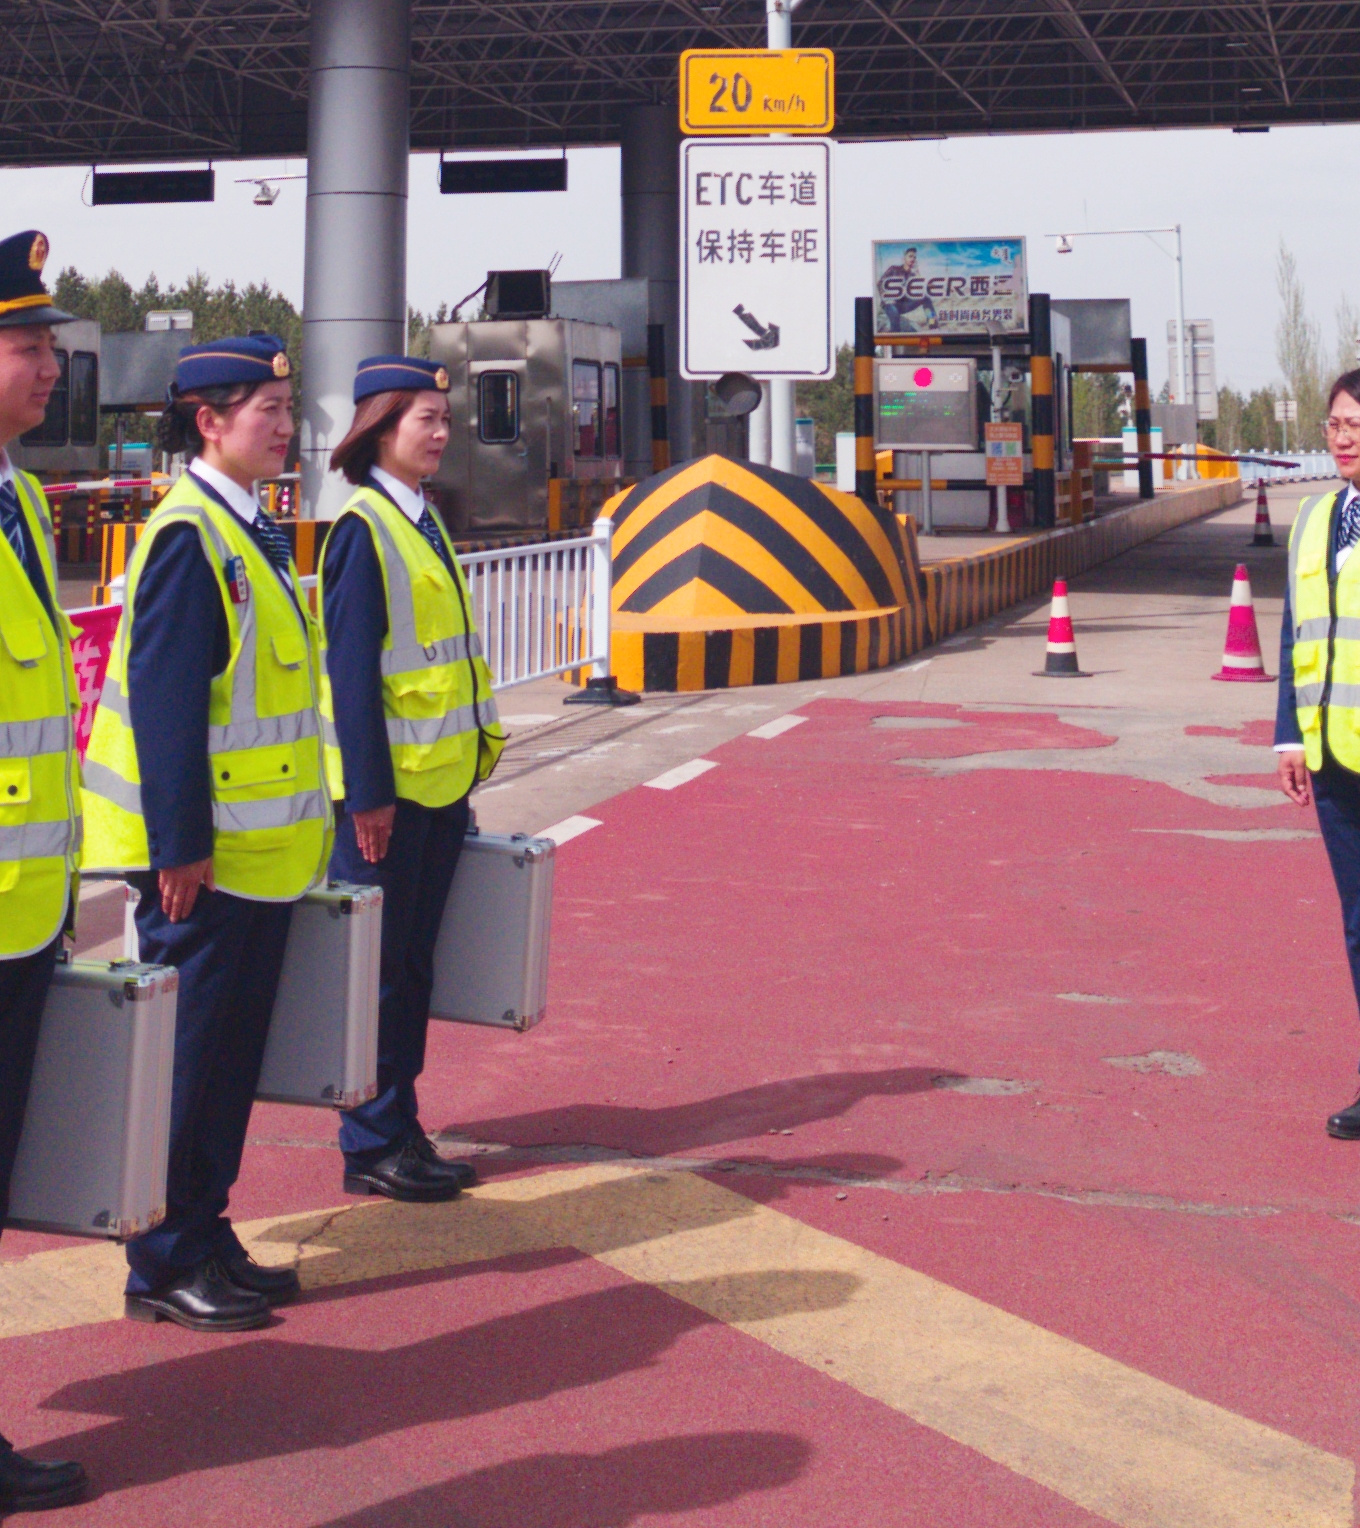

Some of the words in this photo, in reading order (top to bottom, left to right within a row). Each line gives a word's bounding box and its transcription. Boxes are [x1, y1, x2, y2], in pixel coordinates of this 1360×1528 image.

[709, 72, 752, 113] 20
[763, 95, 806, 113] km/h
[696, 171, 817, 206] ETC车道
[696, 229, 818, 264] 保持车距
[883, 275, 967, 298] SEER
